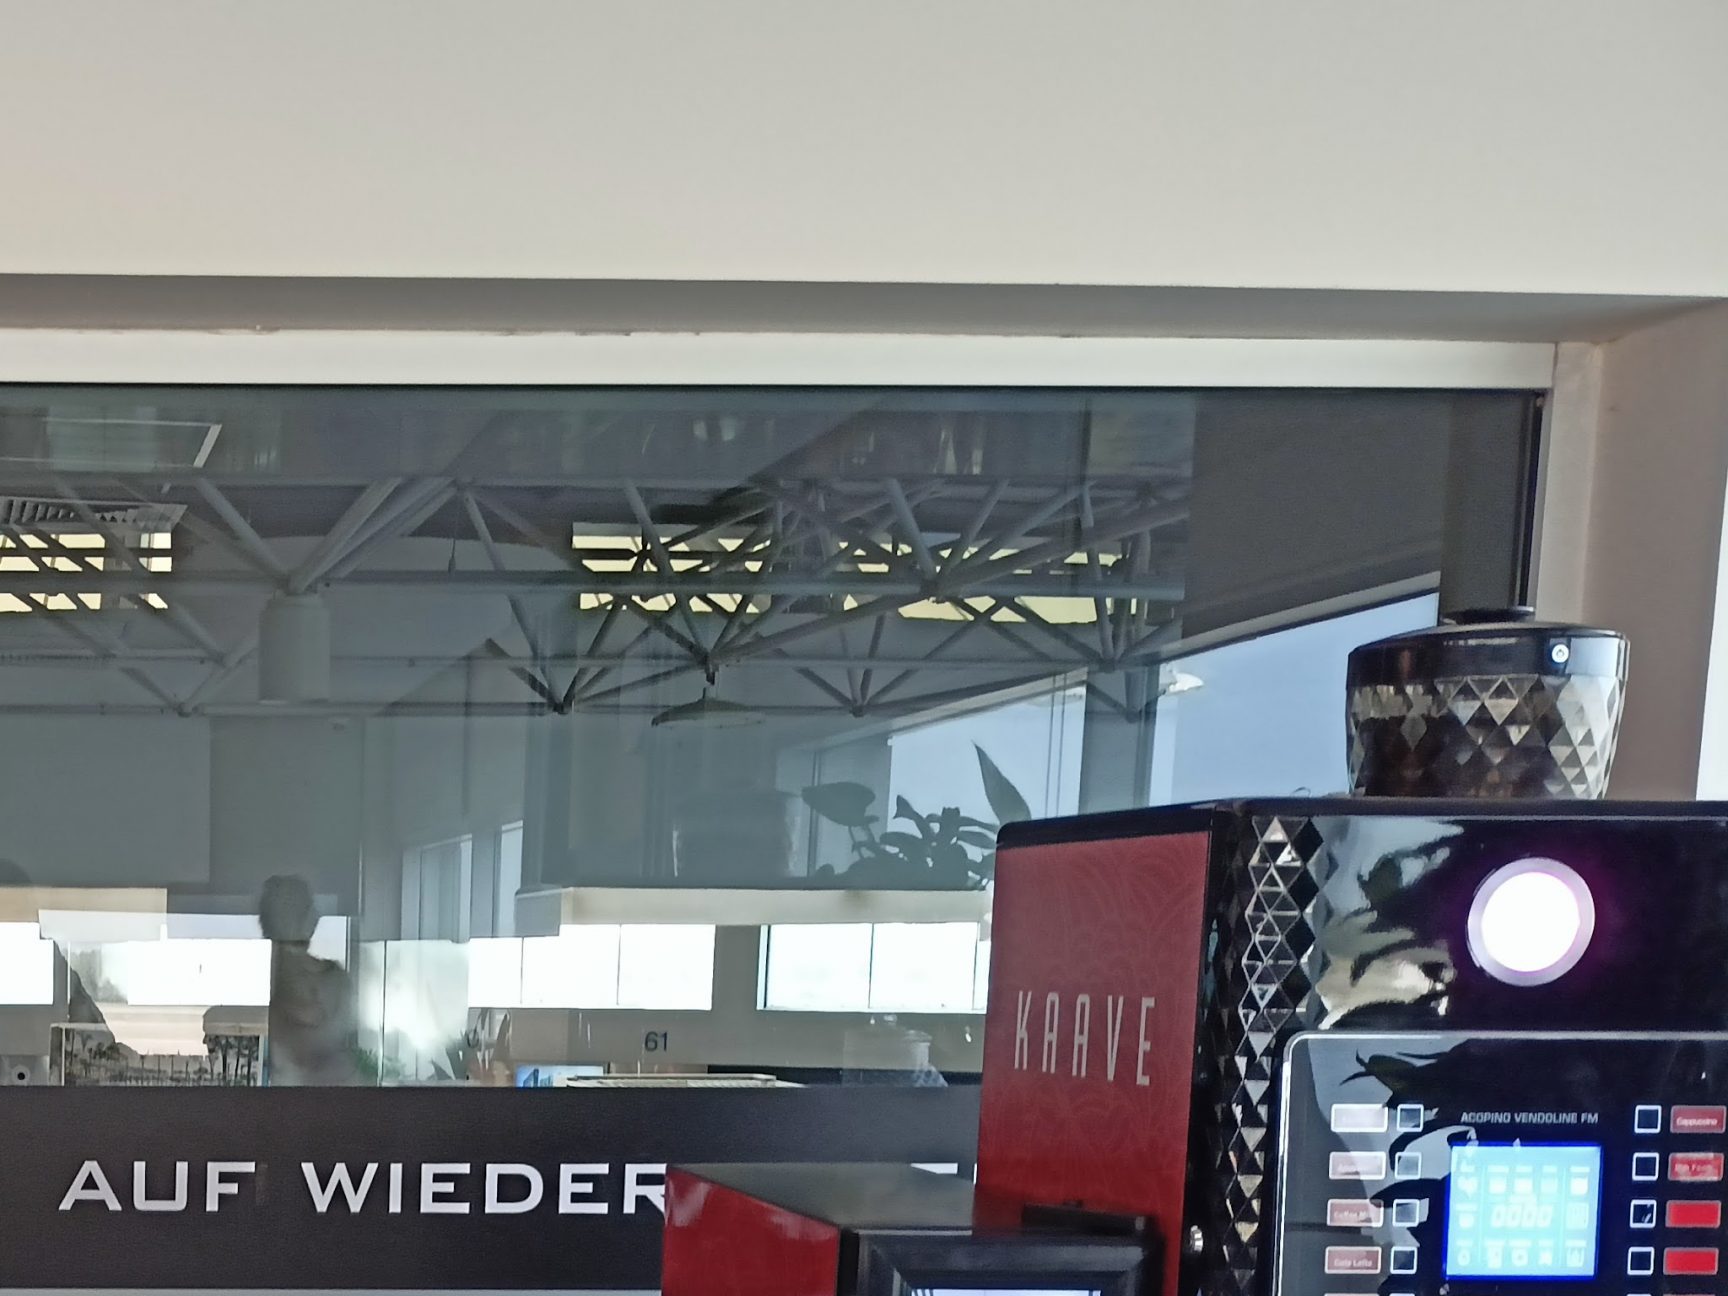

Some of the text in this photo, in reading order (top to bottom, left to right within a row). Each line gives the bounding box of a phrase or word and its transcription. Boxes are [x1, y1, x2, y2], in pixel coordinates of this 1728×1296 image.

[644, 1031, 669, 1052] 61
[1013, 990, 1156, 1087] KAAVE
[1581, 1112, 1599, 1124] FM
[58, 1159, 257, 1213] AUF
